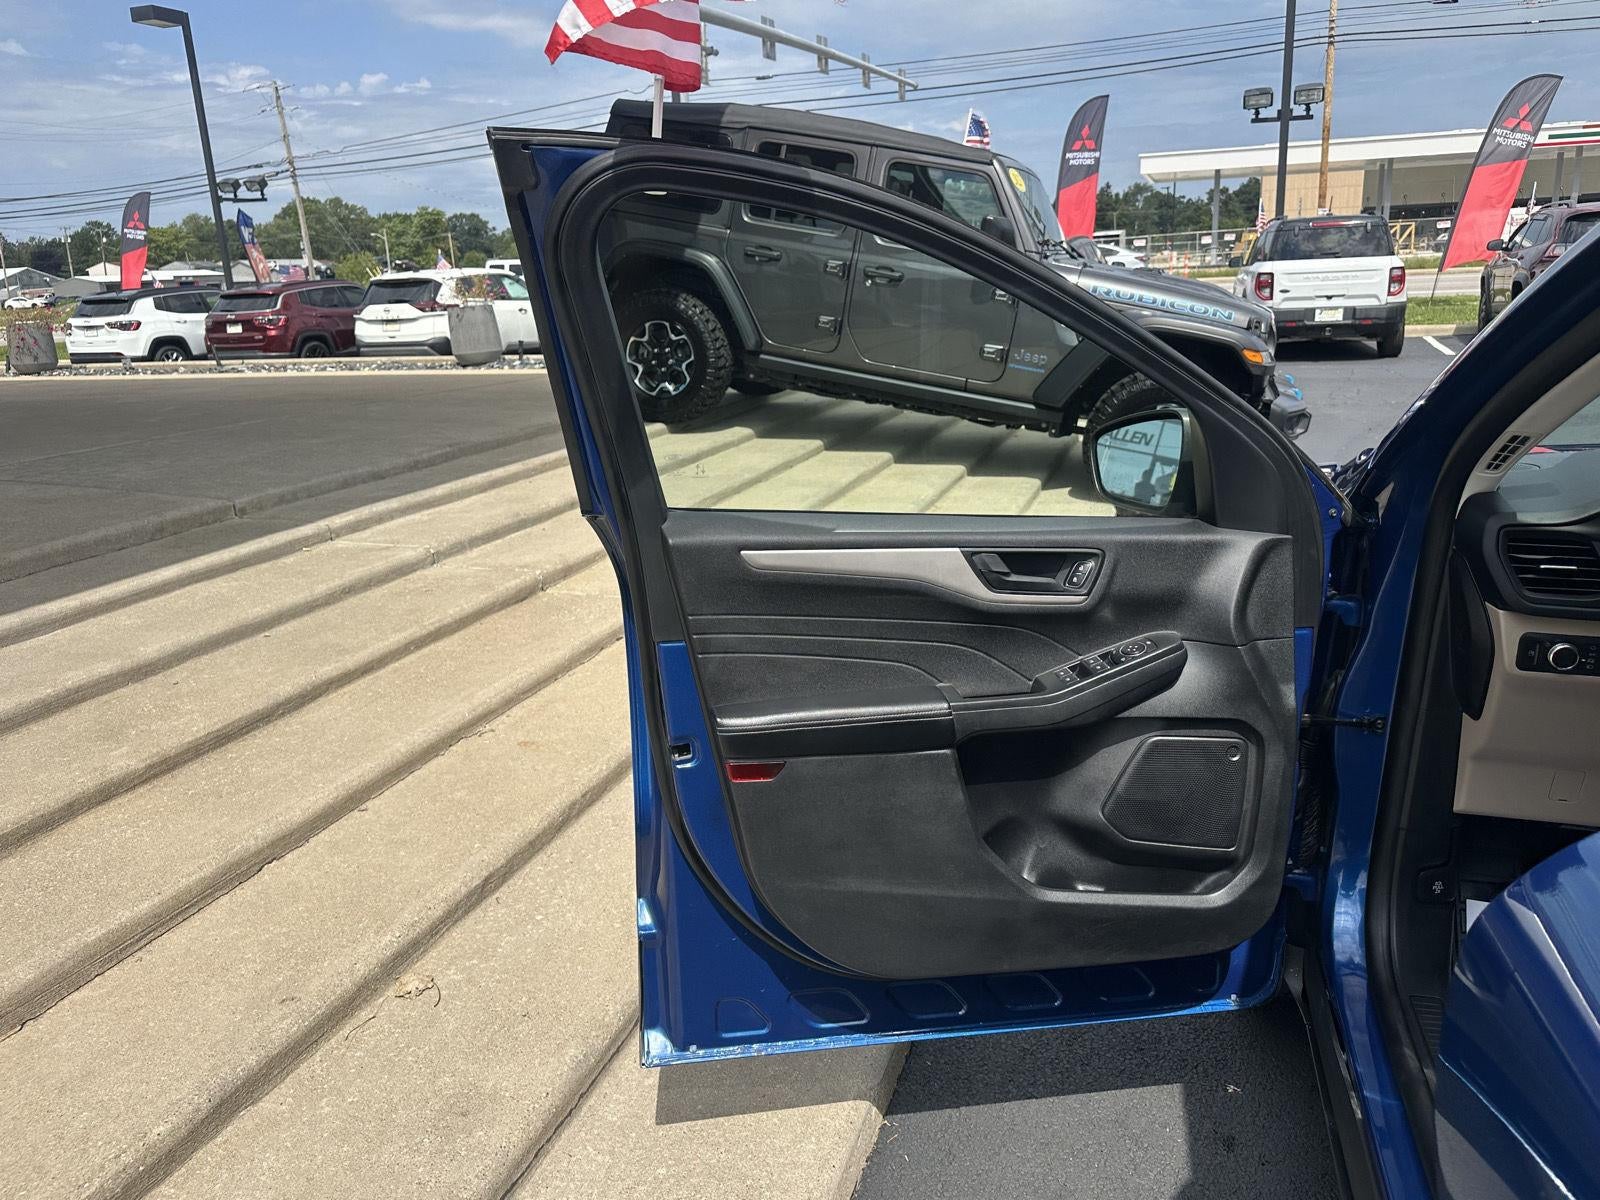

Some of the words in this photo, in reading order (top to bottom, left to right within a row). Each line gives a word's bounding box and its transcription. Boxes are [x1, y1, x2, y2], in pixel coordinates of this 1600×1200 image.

[1492, 127, 1535, 142] MITSUBISHI
[1495, 136, 1528, 148] MOTORS
[1065, 151, 1100, 159] MITSUBISHI
[1069, 157, 1095, 165] MOTORS
[1089, 285, 1235, 321] RUBICON
[1014, 348, 1048, 366] Jeep
